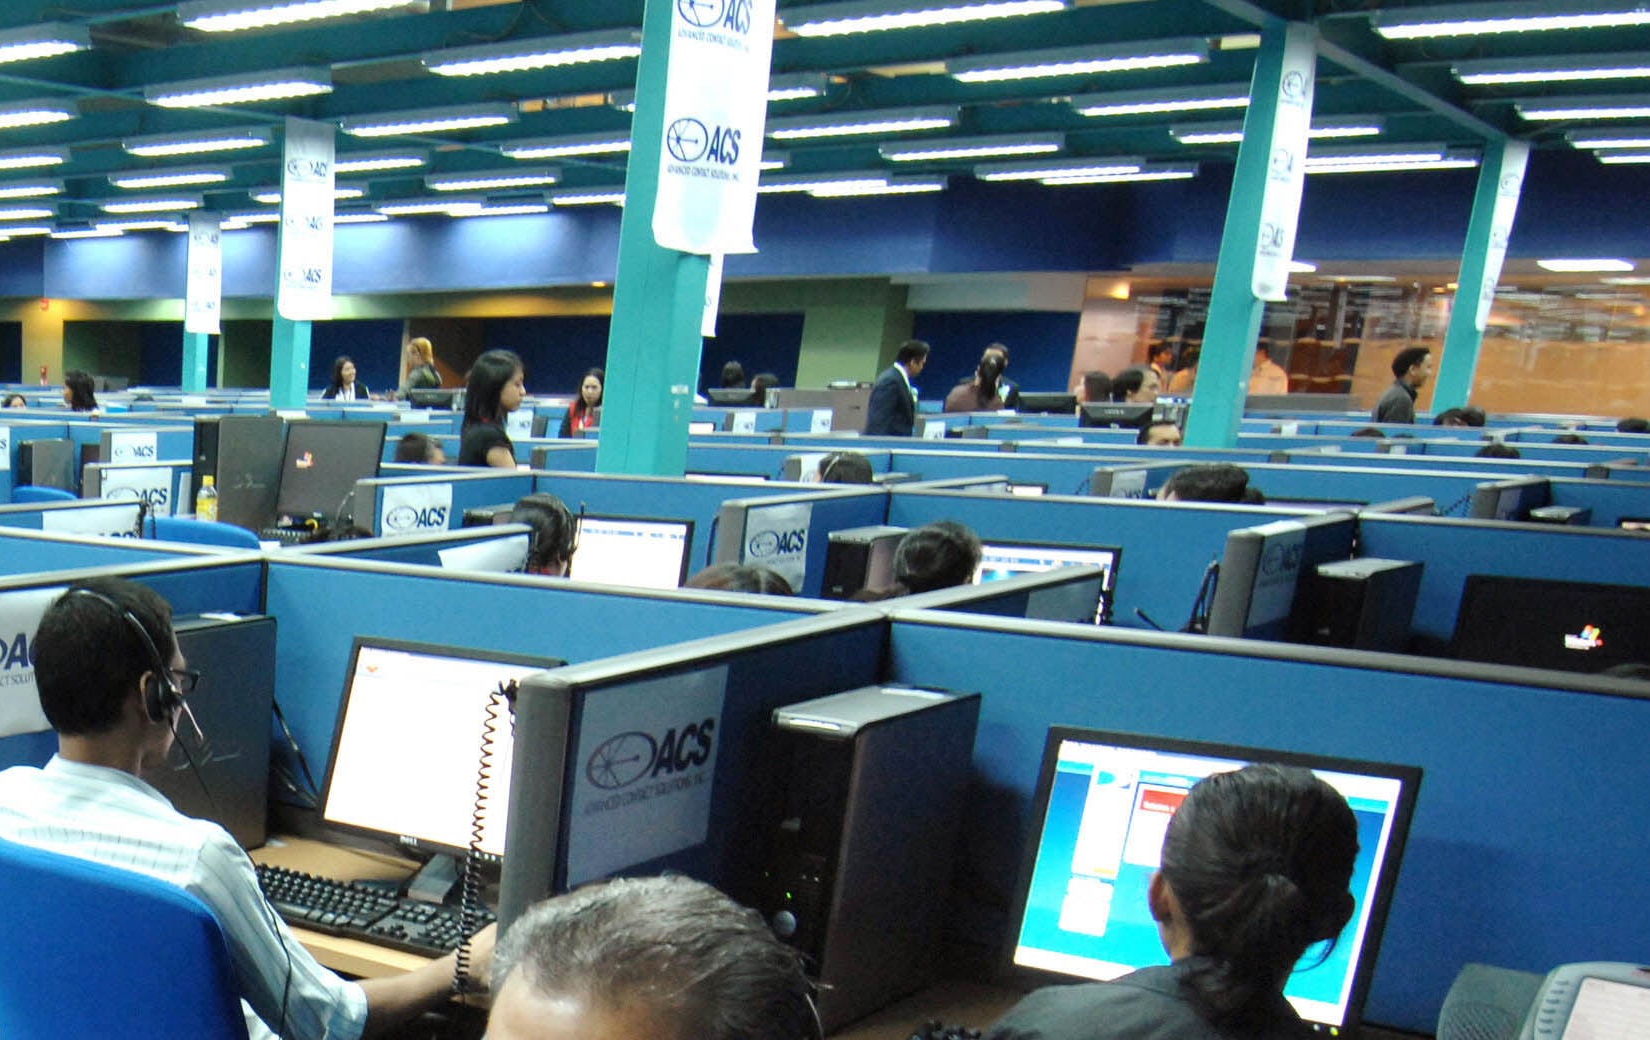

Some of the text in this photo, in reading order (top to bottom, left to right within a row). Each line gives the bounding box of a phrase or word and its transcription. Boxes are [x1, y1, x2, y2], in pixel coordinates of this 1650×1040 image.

[706, 126, 741, 165] ACS
[416, 506, 447, 528] ACS
[777, 529, 805, 554] ACS
[11, 671, 35, 685] SOLUT
[651, 717, 716, 777] ACS
